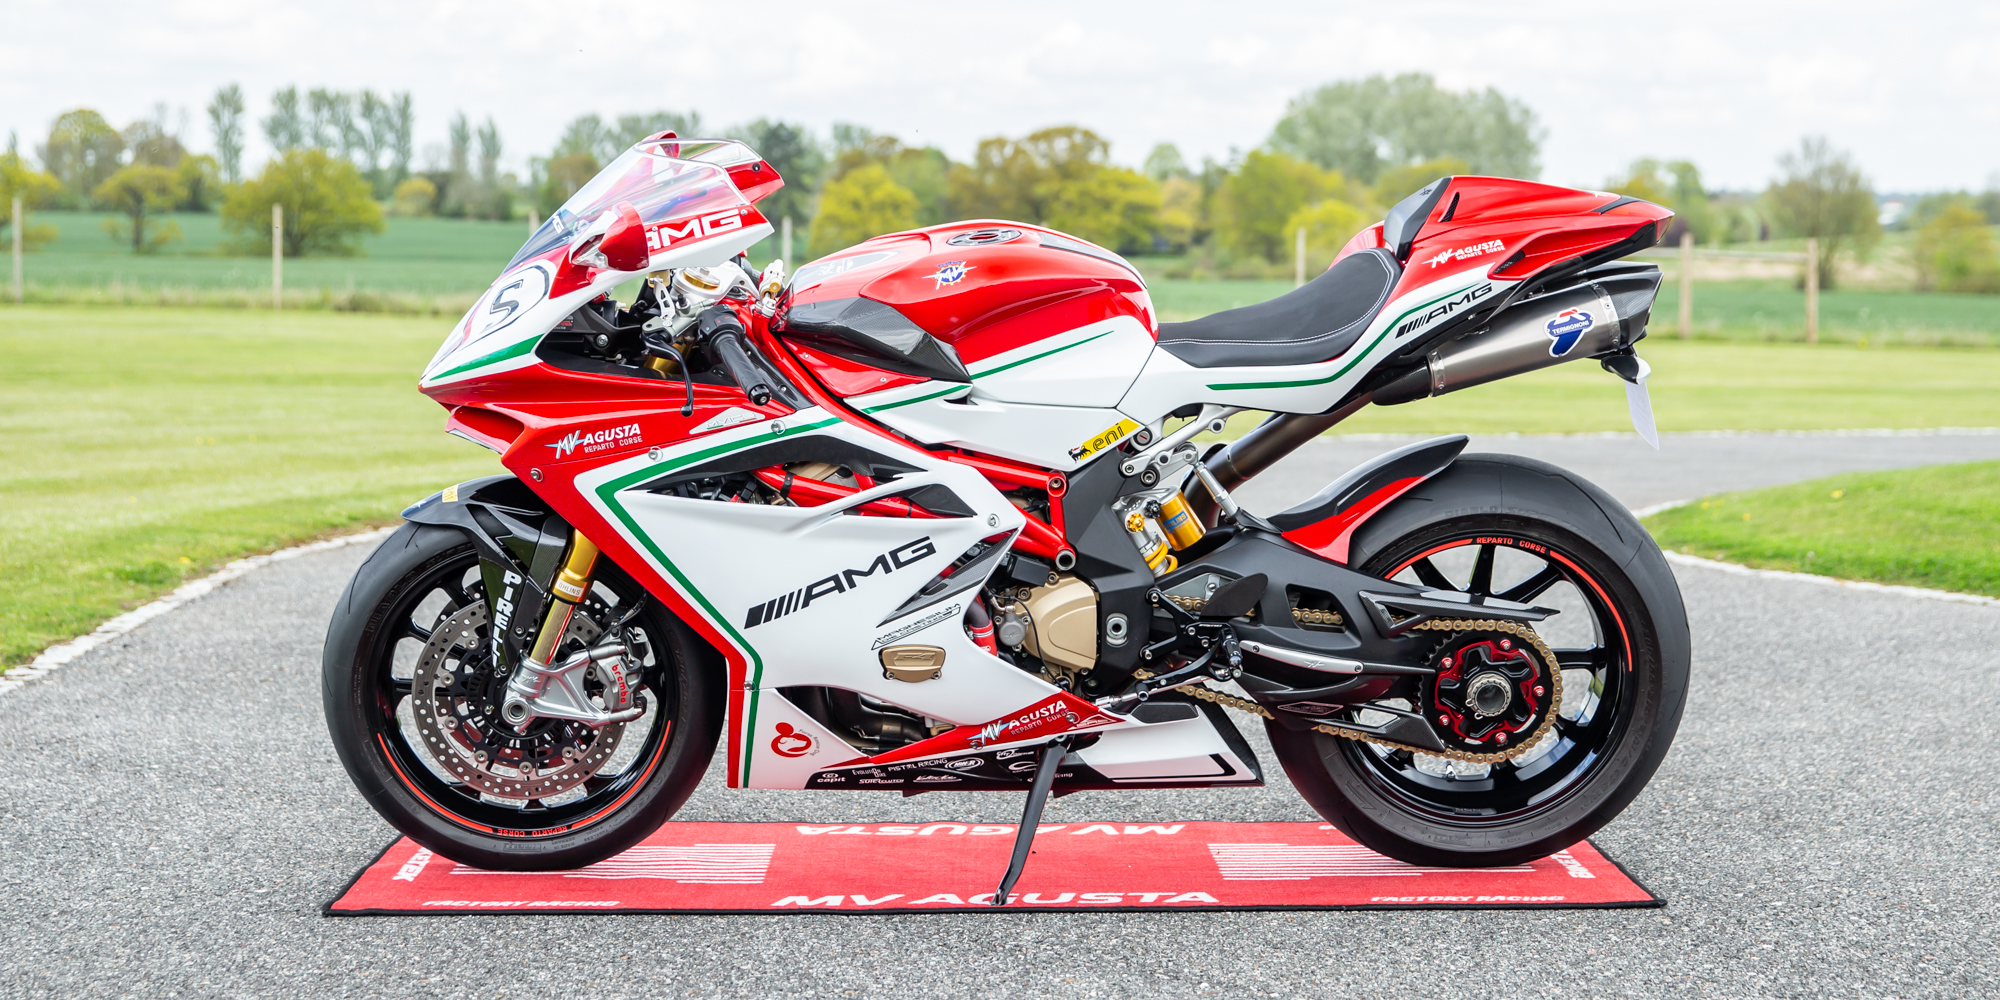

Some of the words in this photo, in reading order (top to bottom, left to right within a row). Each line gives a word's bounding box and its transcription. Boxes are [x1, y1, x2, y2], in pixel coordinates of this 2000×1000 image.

[1455, 239, 1504, 256] AGUSTA
[1456, 250, 1482, 260] REPARTO
[1486, 245, 1505, 254] CORSE
[1425, 282, 1493, 324] AMG
[1552, 320, 1590, 335] TERMIGNONI
[555, 429, 581, 459] MV
[583, 423, 641, 445] AGUSTA
[584, 442, 615, 454] REPARTO
[619, 435, 643, 447] CORSE
[1093, 423, 1125, 451] eni
[1476, 537, 1513, 545] REPARTO
[1519, 540, 1547, 554] CORSE
[801, 536, 937, 609] AMG
[492, 569, 522, 669] PIRELLI
[611, 663, 629, 704] brembo
[981, 719, 1003, 745] MV
[1008, 700, 1067, 729] AGUSTA
[1010, 720, 1043, 735] REPARTO
[497, 828, 526, 838] CORSE
[532, 826, 568, 838] REPARTO
[392, 847, 434, 882] KETEK
[771, 894, 905, 906] MV
[908, 891, 1220, 905] AGUSTA
